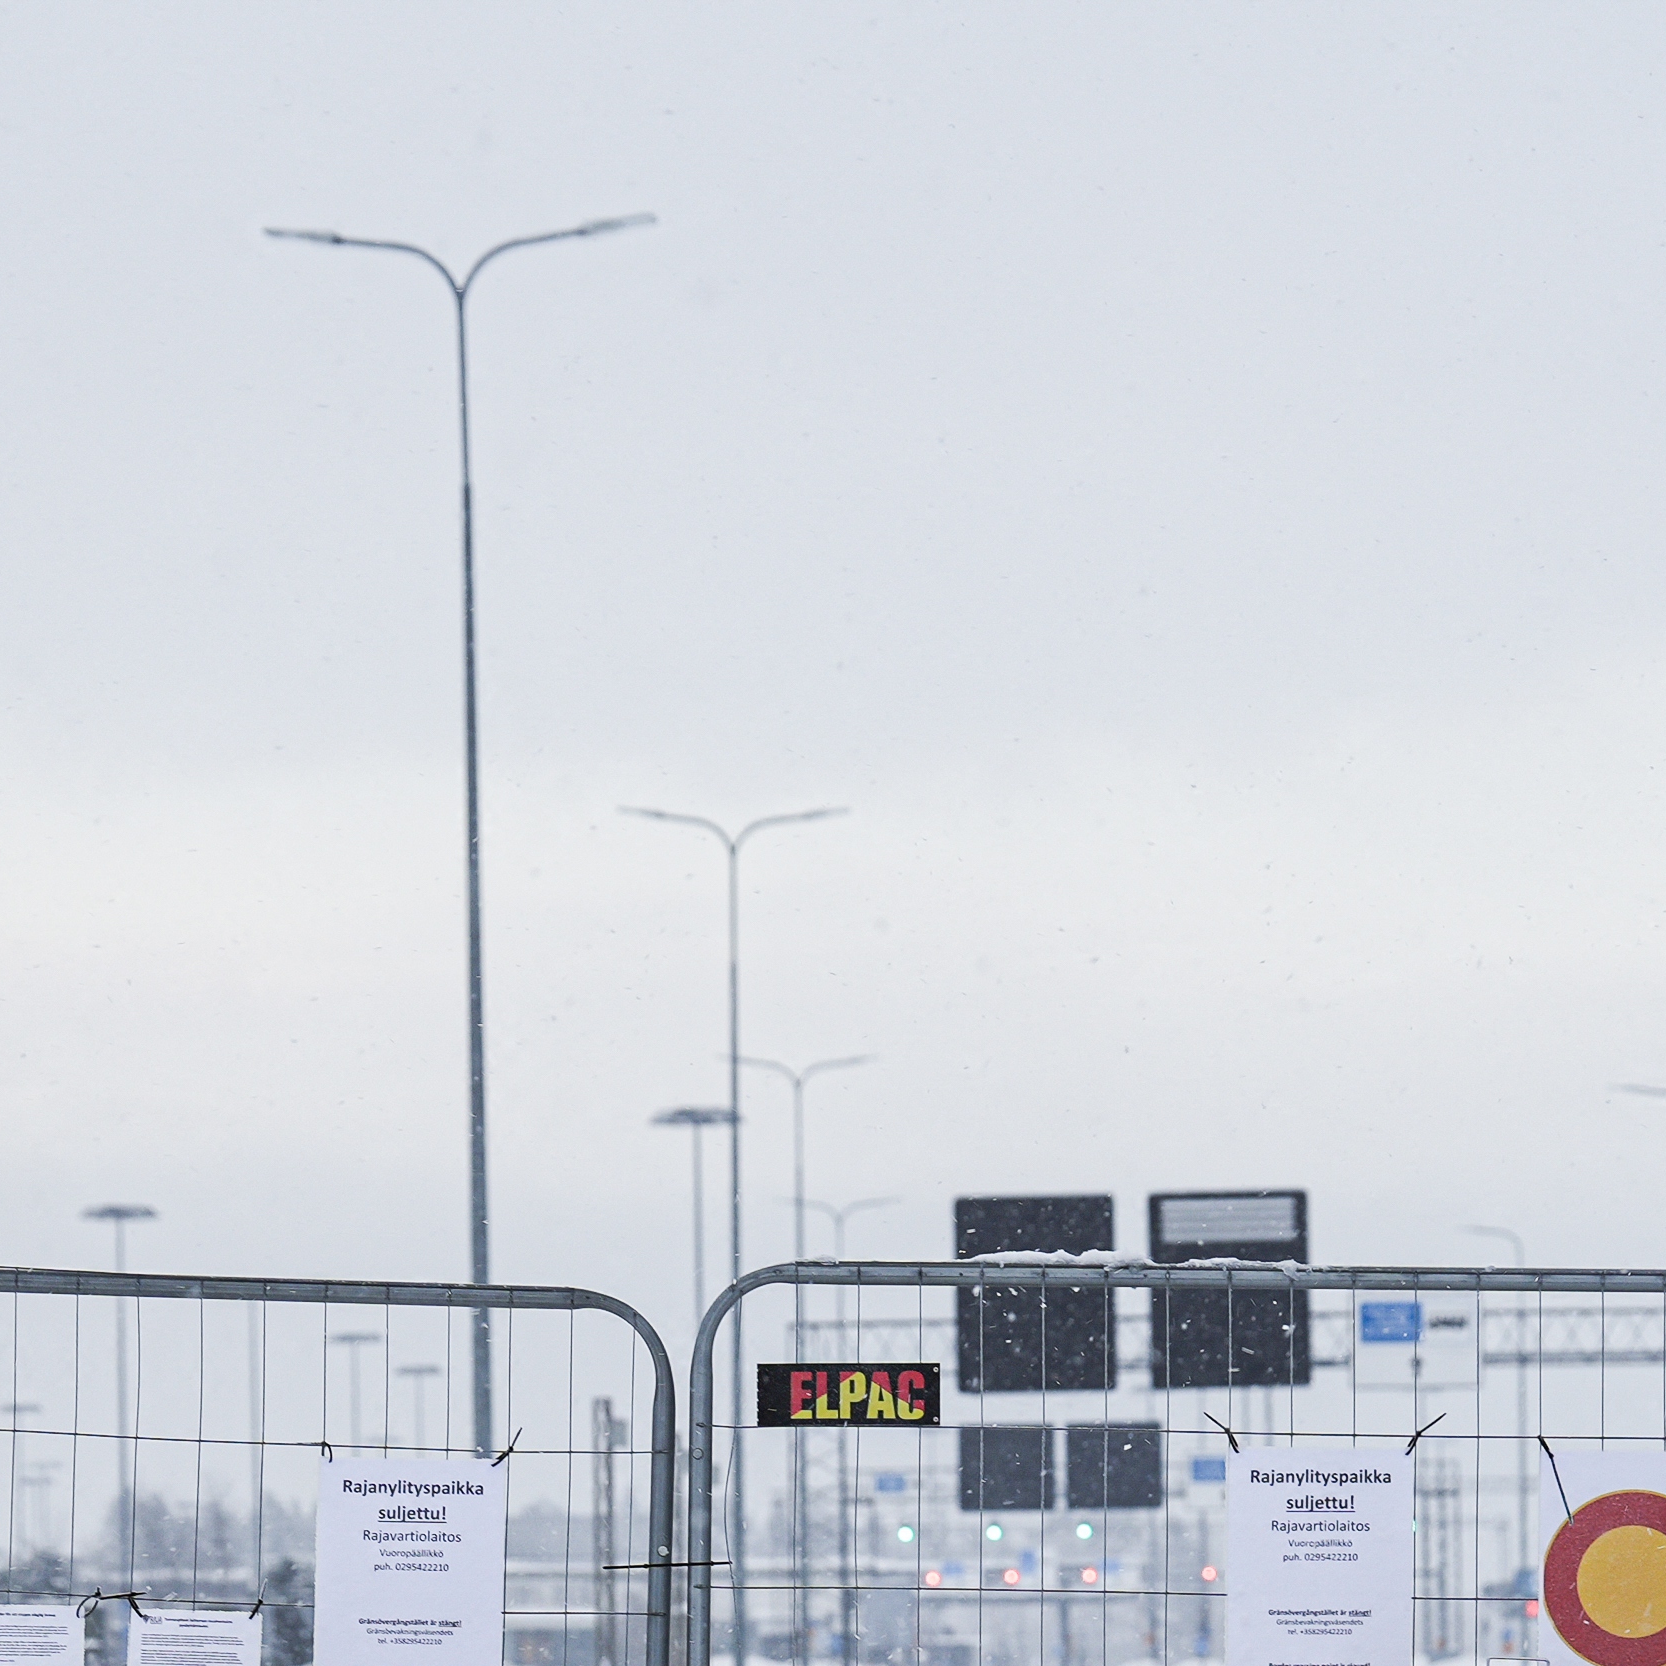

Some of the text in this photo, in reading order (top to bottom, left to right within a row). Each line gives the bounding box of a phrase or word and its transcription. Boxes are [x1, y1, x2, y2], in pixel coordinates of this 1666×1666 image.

[790, 1370, 925, 1420] ELPAC
[1250, 1469, 1392, 1486] Rajanylityspaikka
[343, 1479, 484, 1497] Rajanylityspaikka
[1286, 1495, 1355, 1512] suljettu!
[378, 1506, 447, 1523] suljettu!
[1271, 1520, 1370, 1534] Rajavartiolaitos
[363, 1529, 462, 1543] Rajavartiolaitos
[1283, 1553, 1358, 1562] puh. 0295422210
[374, 1563, 450, 1572] puh. 0295422210
